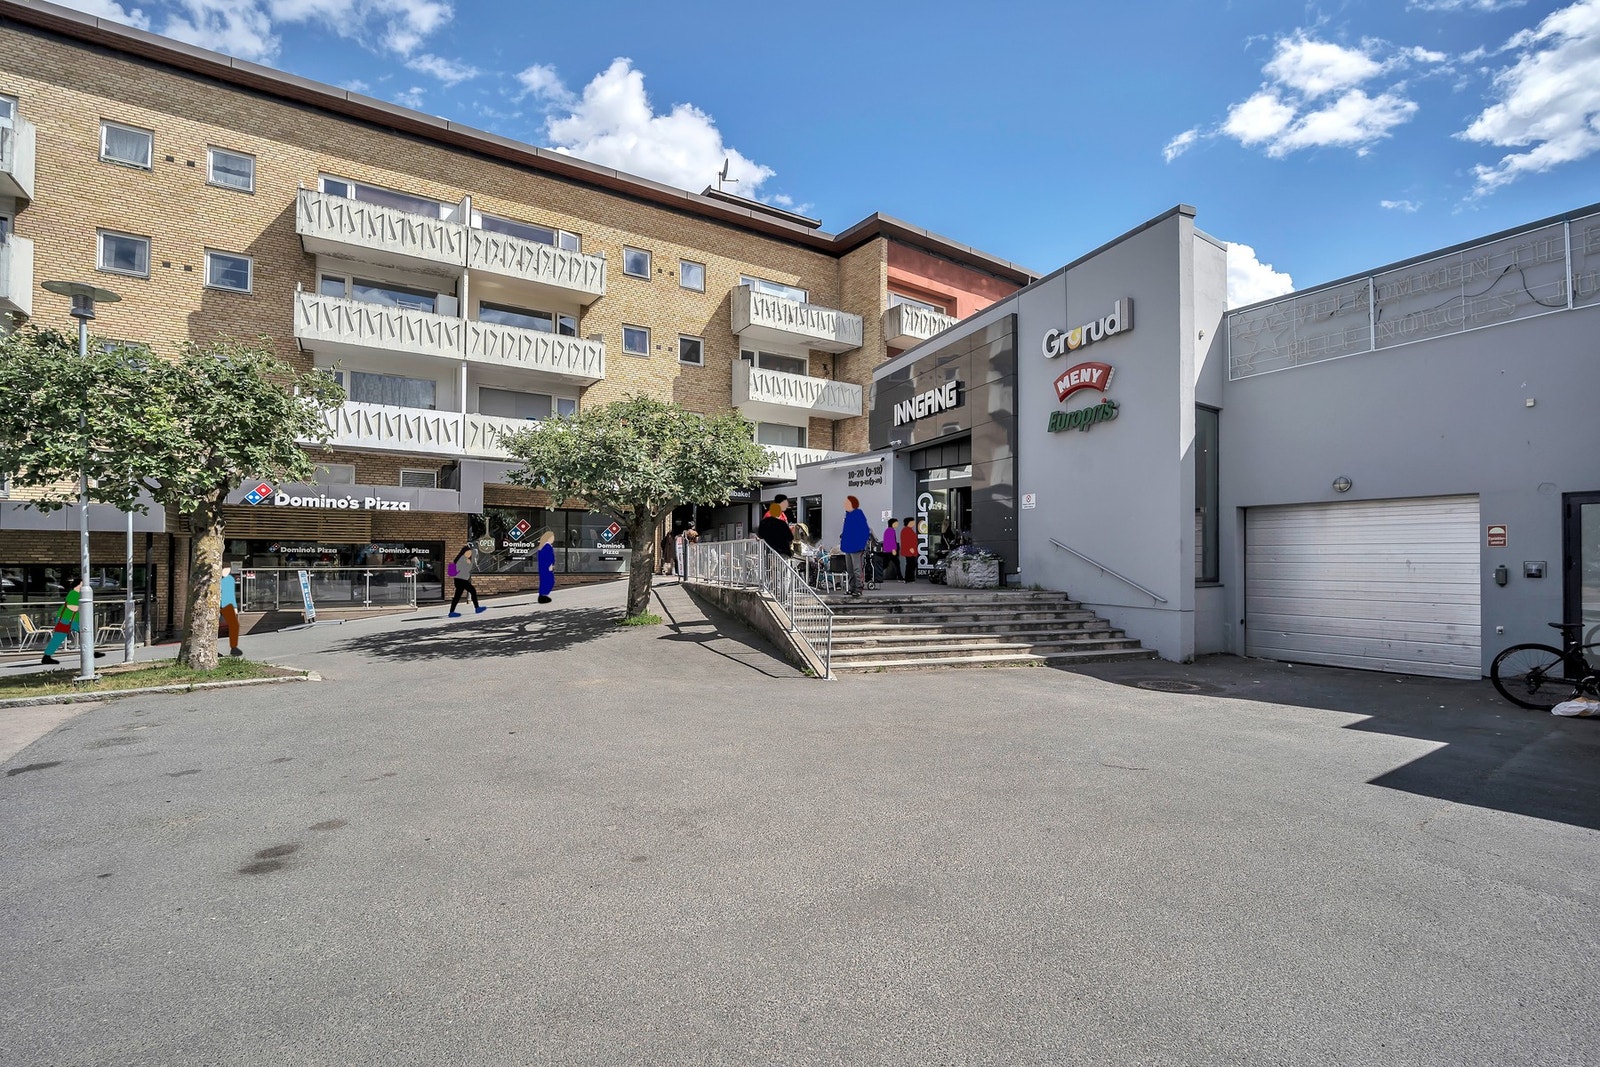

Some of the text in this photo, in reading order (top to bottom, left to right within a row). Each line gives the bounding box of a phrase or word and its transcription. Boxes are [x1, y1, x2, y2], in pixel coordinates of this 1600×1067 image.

[1042, 299, 1122, 358] Grorud
[1057, 368, 1103, 394] MENY
[893, 380, 958, 427] INNGANG
[1047, 398, 1117, 432] Europris
[848, 464, 883, 479] 10-20 (9-18)
[274, 493, 410, 511] Domino's Pizza
[917, 492, 934, 569] Grorud
[280, 546, 316, 554] Domino's
[479, 539, 495, 547] OPEN
[502, 540, 535, 548] Domino's
